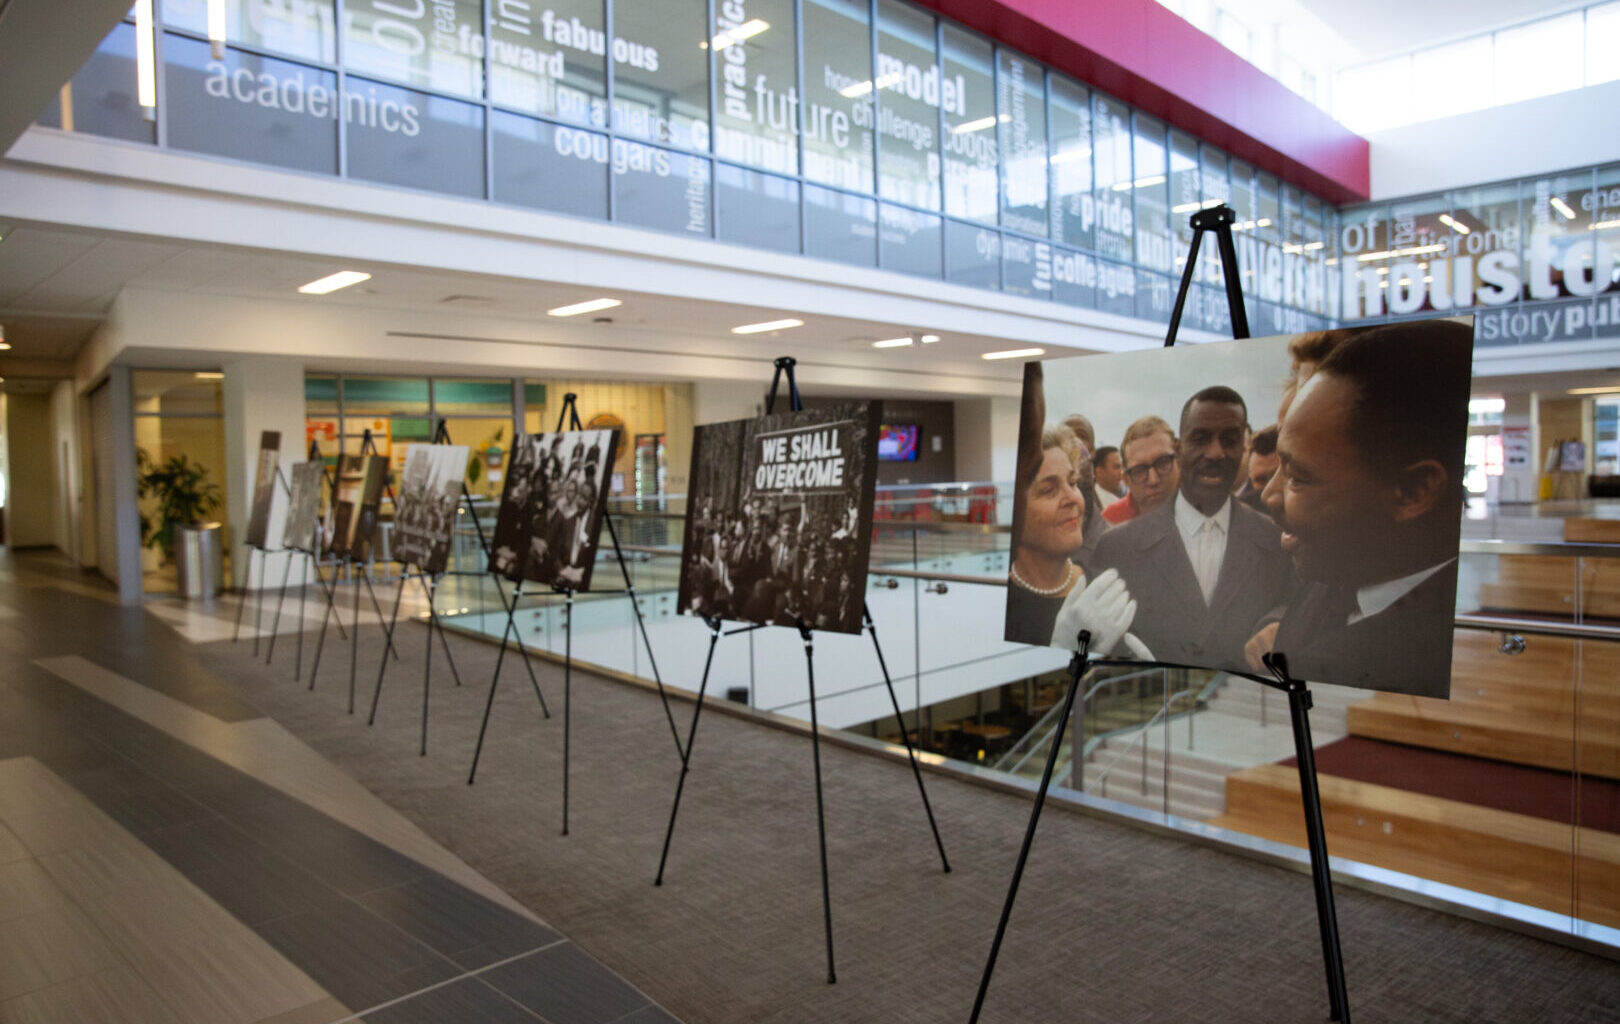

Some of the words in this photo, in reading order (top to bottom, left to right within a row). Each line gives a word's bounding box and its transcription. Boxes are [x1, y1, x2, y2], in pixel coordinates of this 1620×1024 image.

[457, 24, 565, 80] forward
[541, 9, 660, 73] fabuous
[204, 60, 421, 137] academics
[753, 74, 850, 148] future
[877, 52, 967, 118] model
[591, 98, 680, 144] ahletics
[554, 127, 671, 178] cougars
[1342, 213, 1379, 253] of
[762, 436, 787, 464] WE
[790, 429, 842, 462] SHALL
[755, 458, 845, 490] OVERCOME
